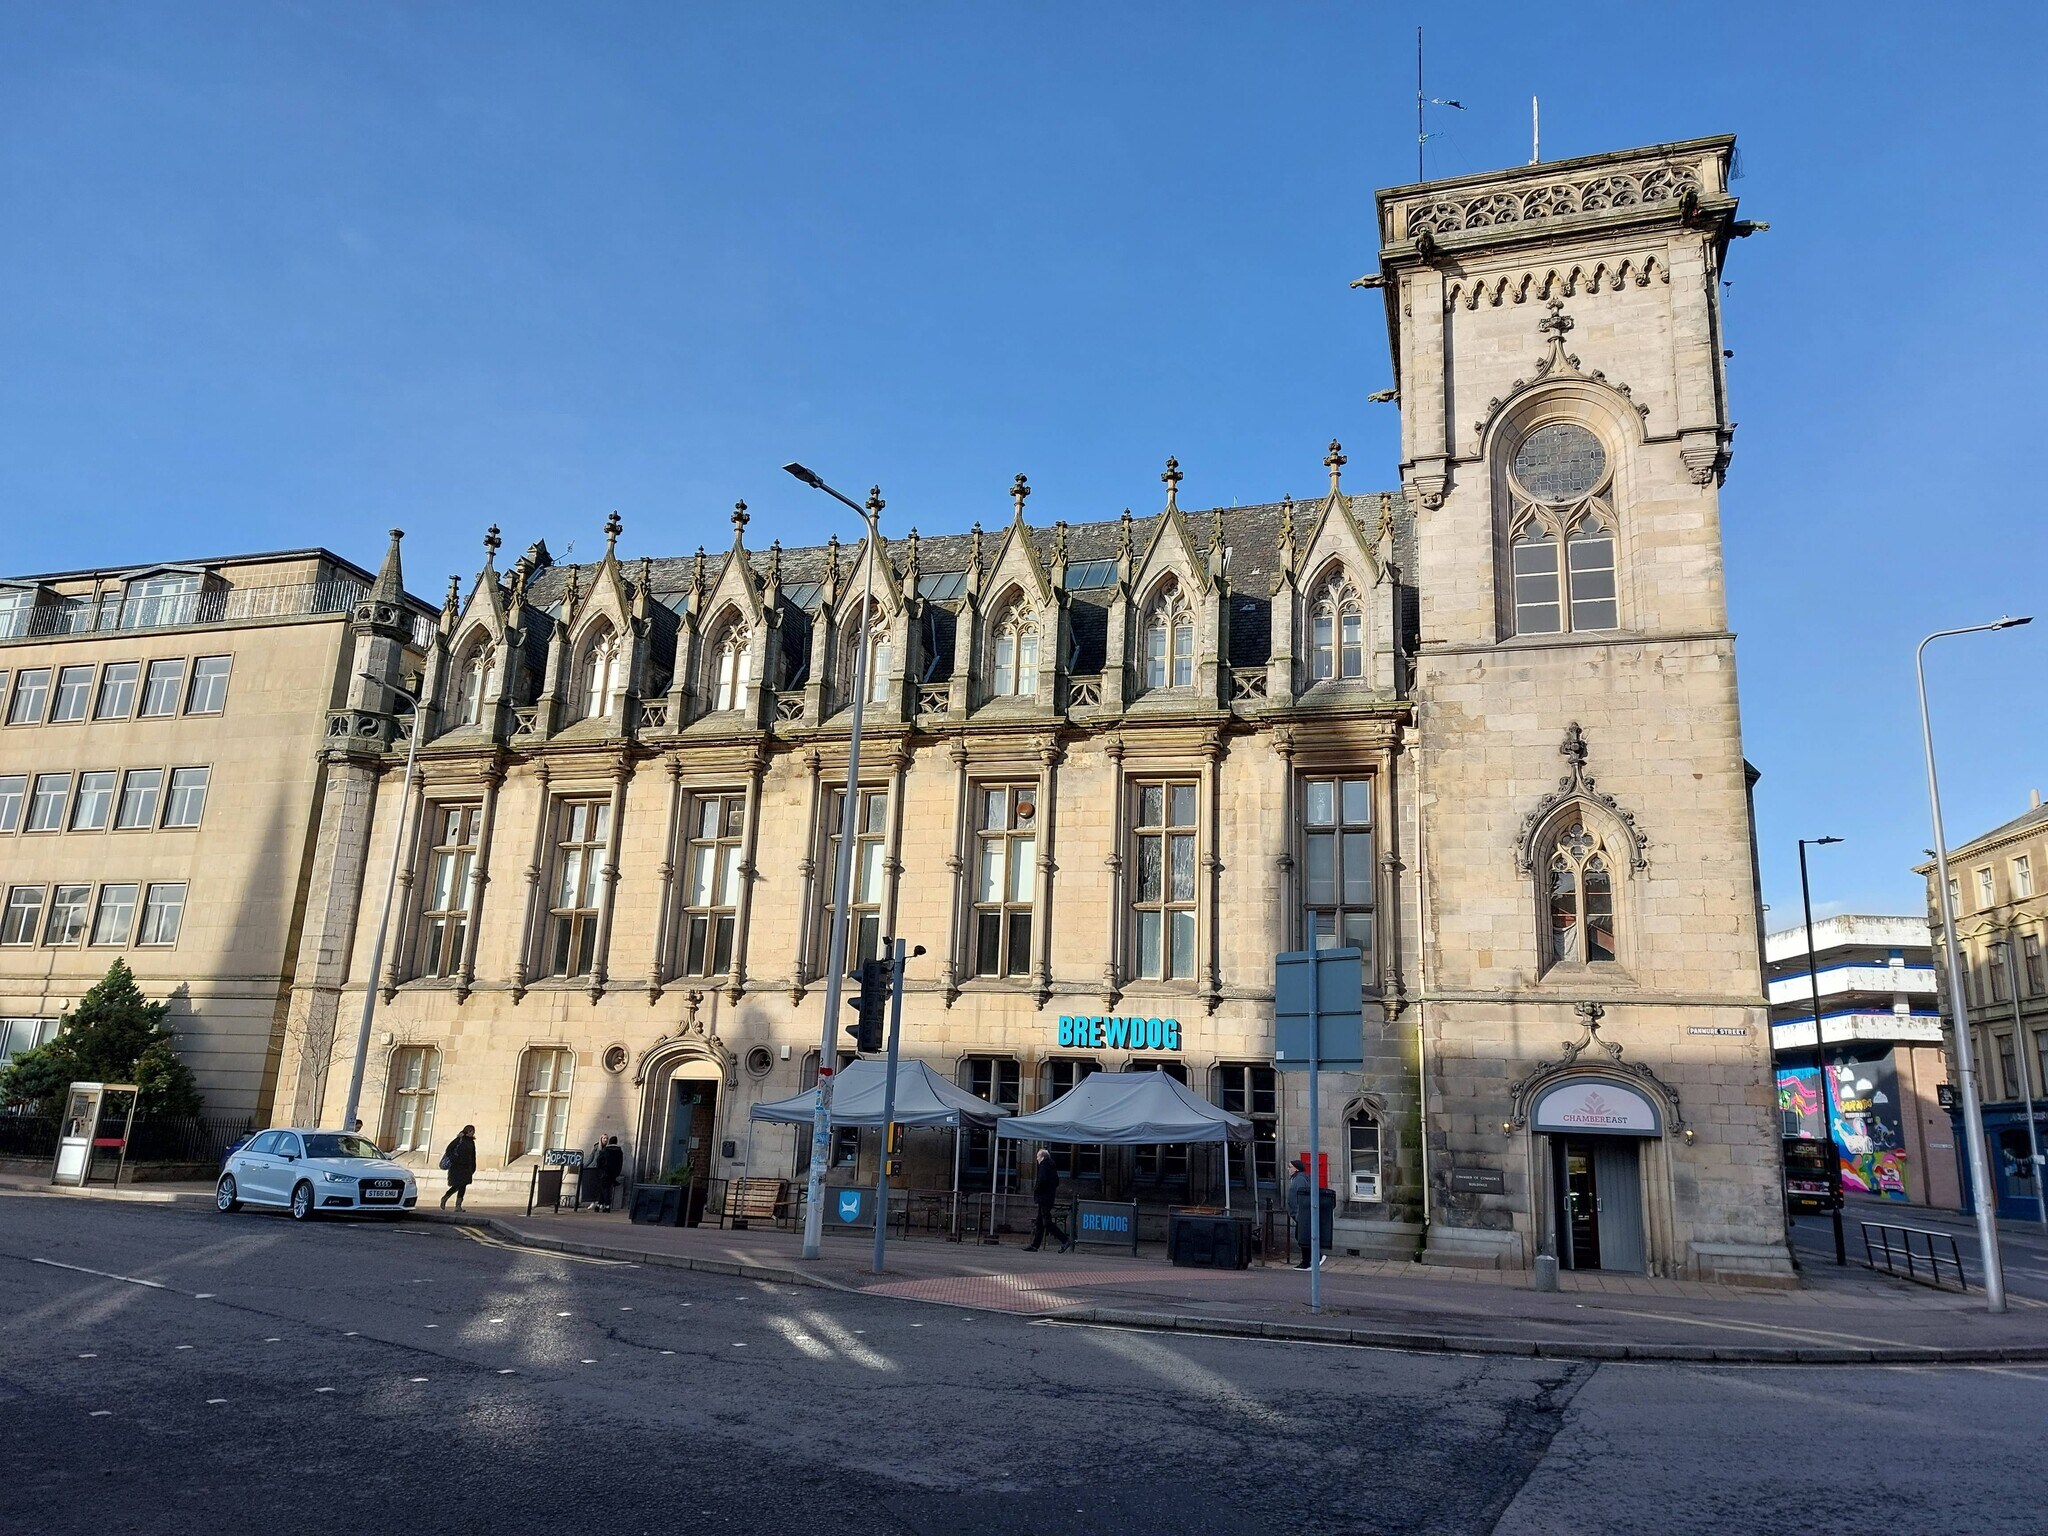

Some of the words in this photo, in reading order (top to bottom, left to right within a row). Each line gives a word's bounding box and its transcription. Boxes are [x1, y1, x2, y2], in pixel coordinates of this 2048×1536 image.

[1058, 1015, 1182, 1051] BREWDOG
[1563, 1114, 1628, 1124] CHAMBEREAST
[1082, 1213, 1128, 1232] BREWDOG
